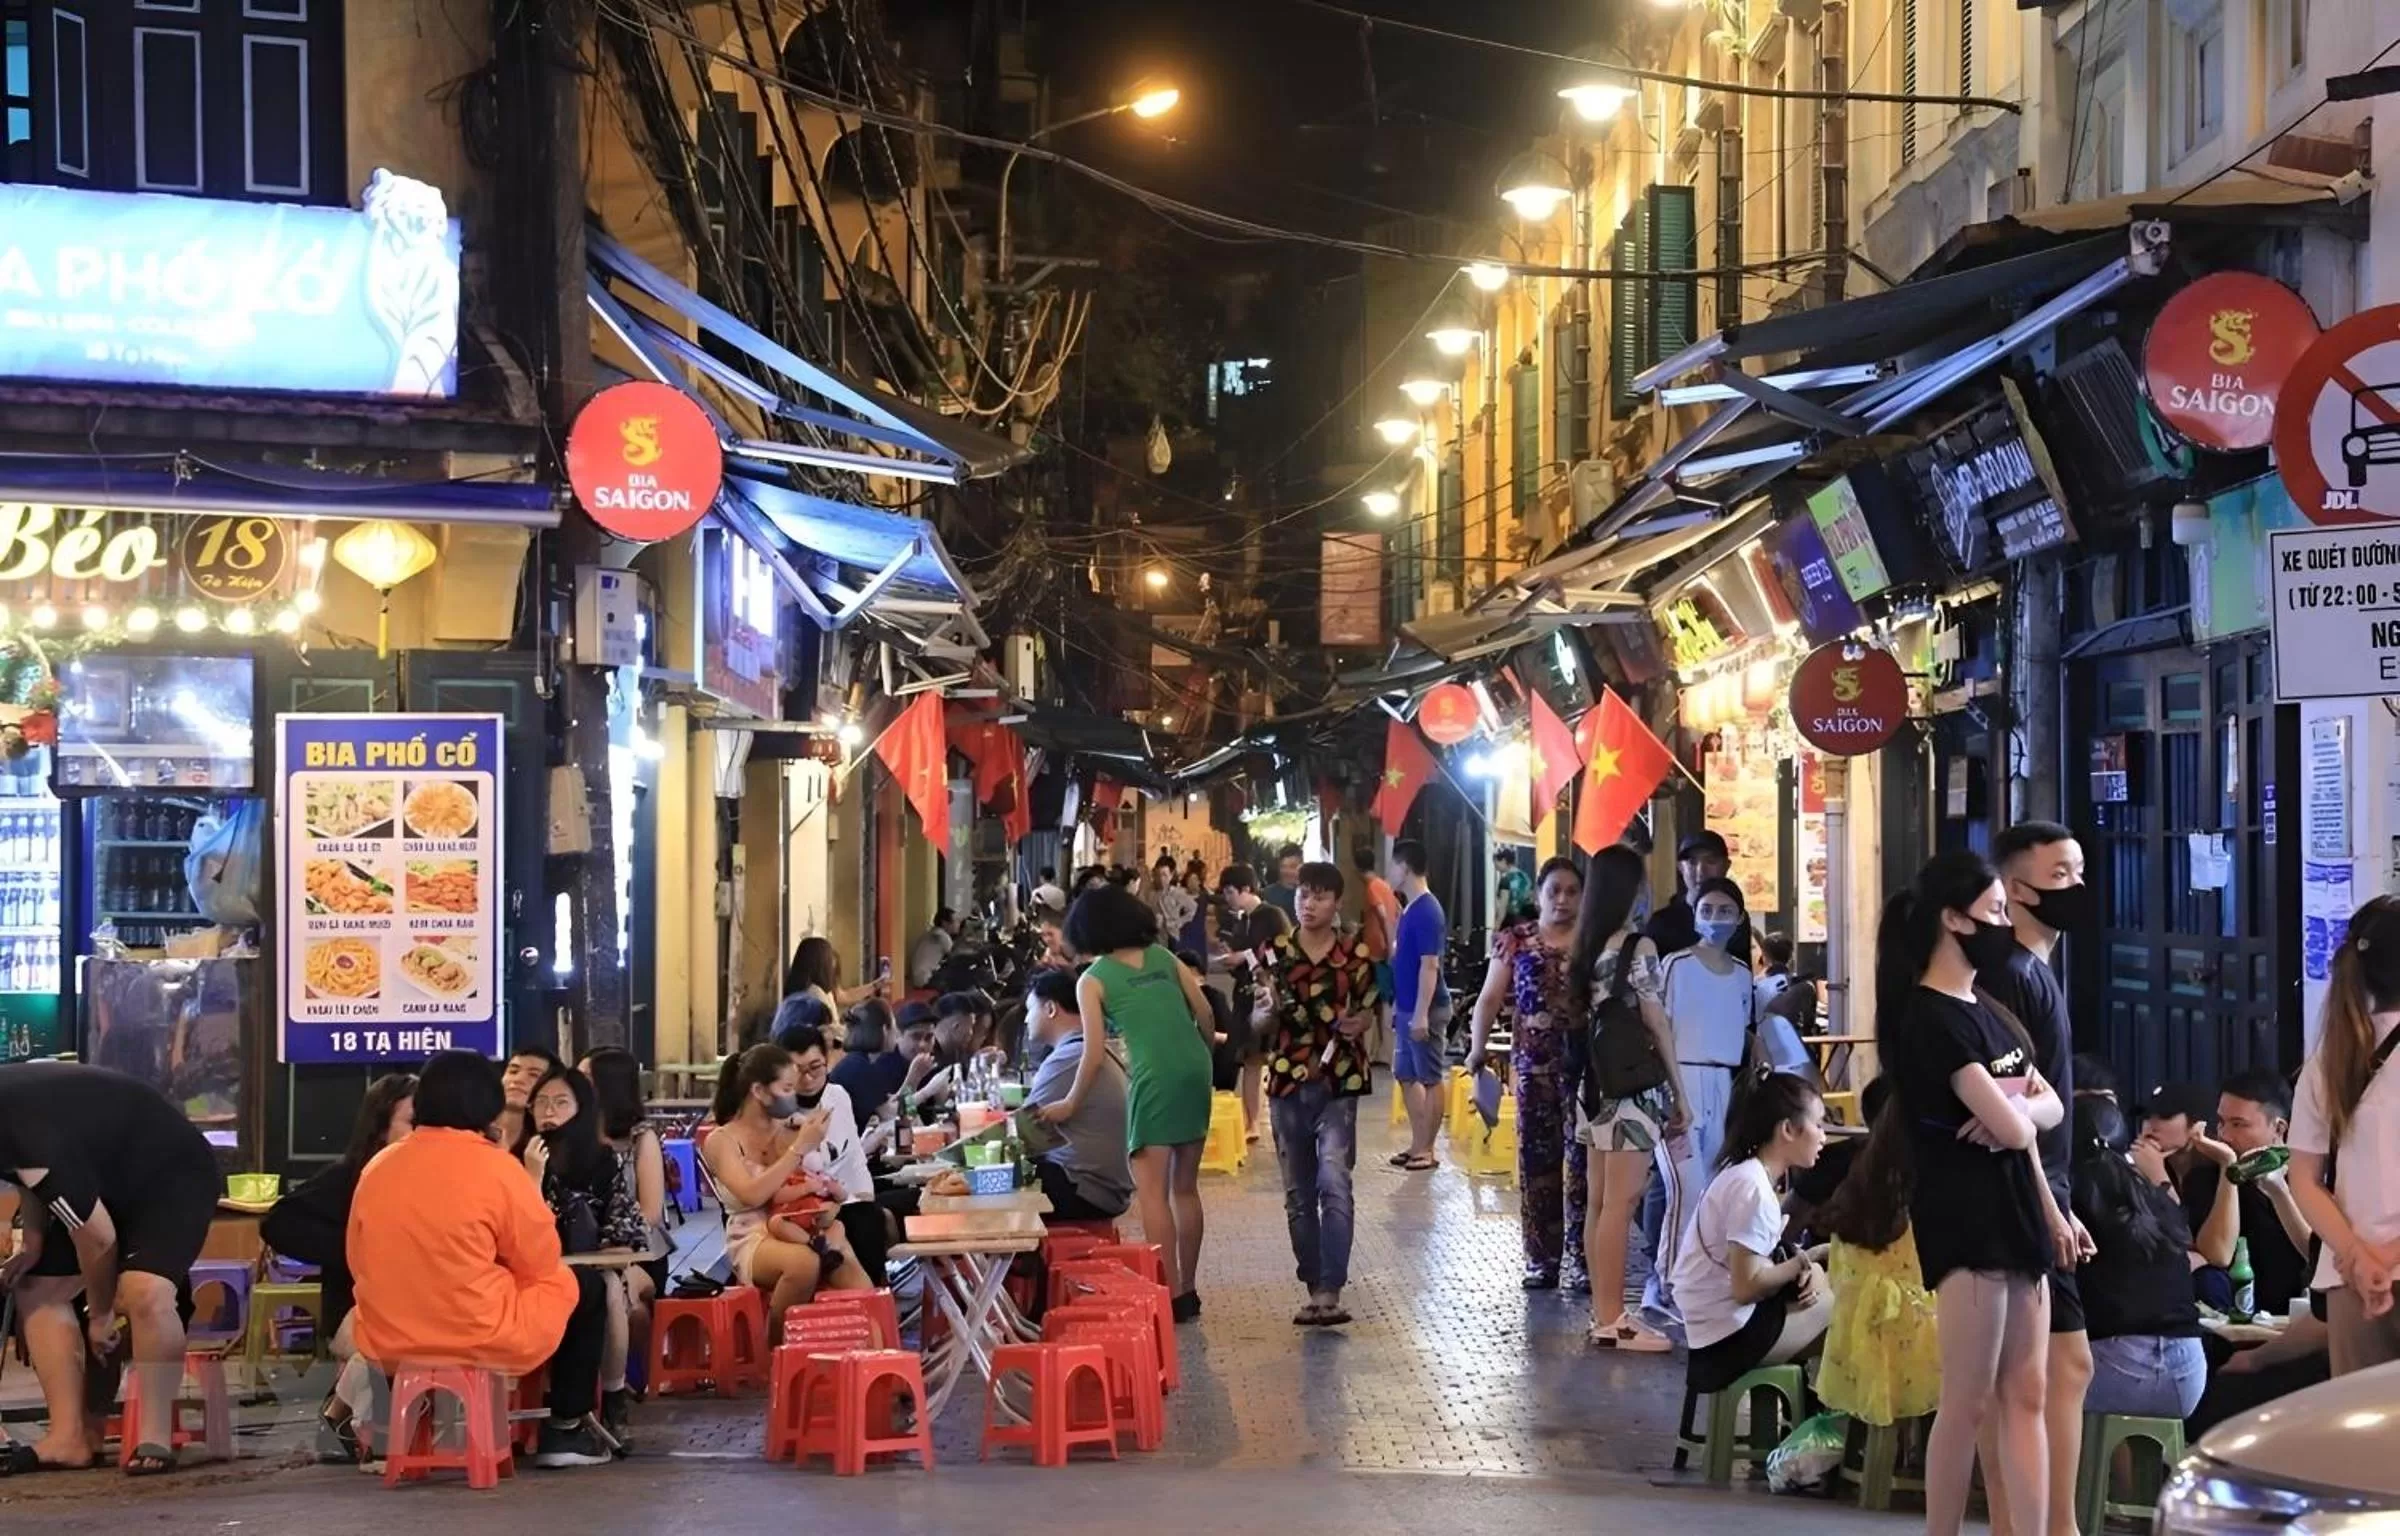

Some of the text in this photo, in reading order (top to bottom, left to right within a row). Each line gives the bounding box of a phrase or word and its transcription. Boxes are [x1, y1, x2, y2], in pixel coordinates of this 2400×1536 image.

[2211, 372, 2244, 390] BIA
[594, 487, 690, 511] SAIGON
[2322, 491, 2358, 510] JDL
[195, 517, 275, 570] 18
[2282, 551, 2303, 572] XE
[2308, 542, 2347, 570] QUÉT
[1813, 718, 1883, 733] SAIGON
[306, 741, 357, 767] BIA
[366, 732, 427, 767] PHỐ
[330, 1026, 452, 1056] 18 TẠ HIỆN
